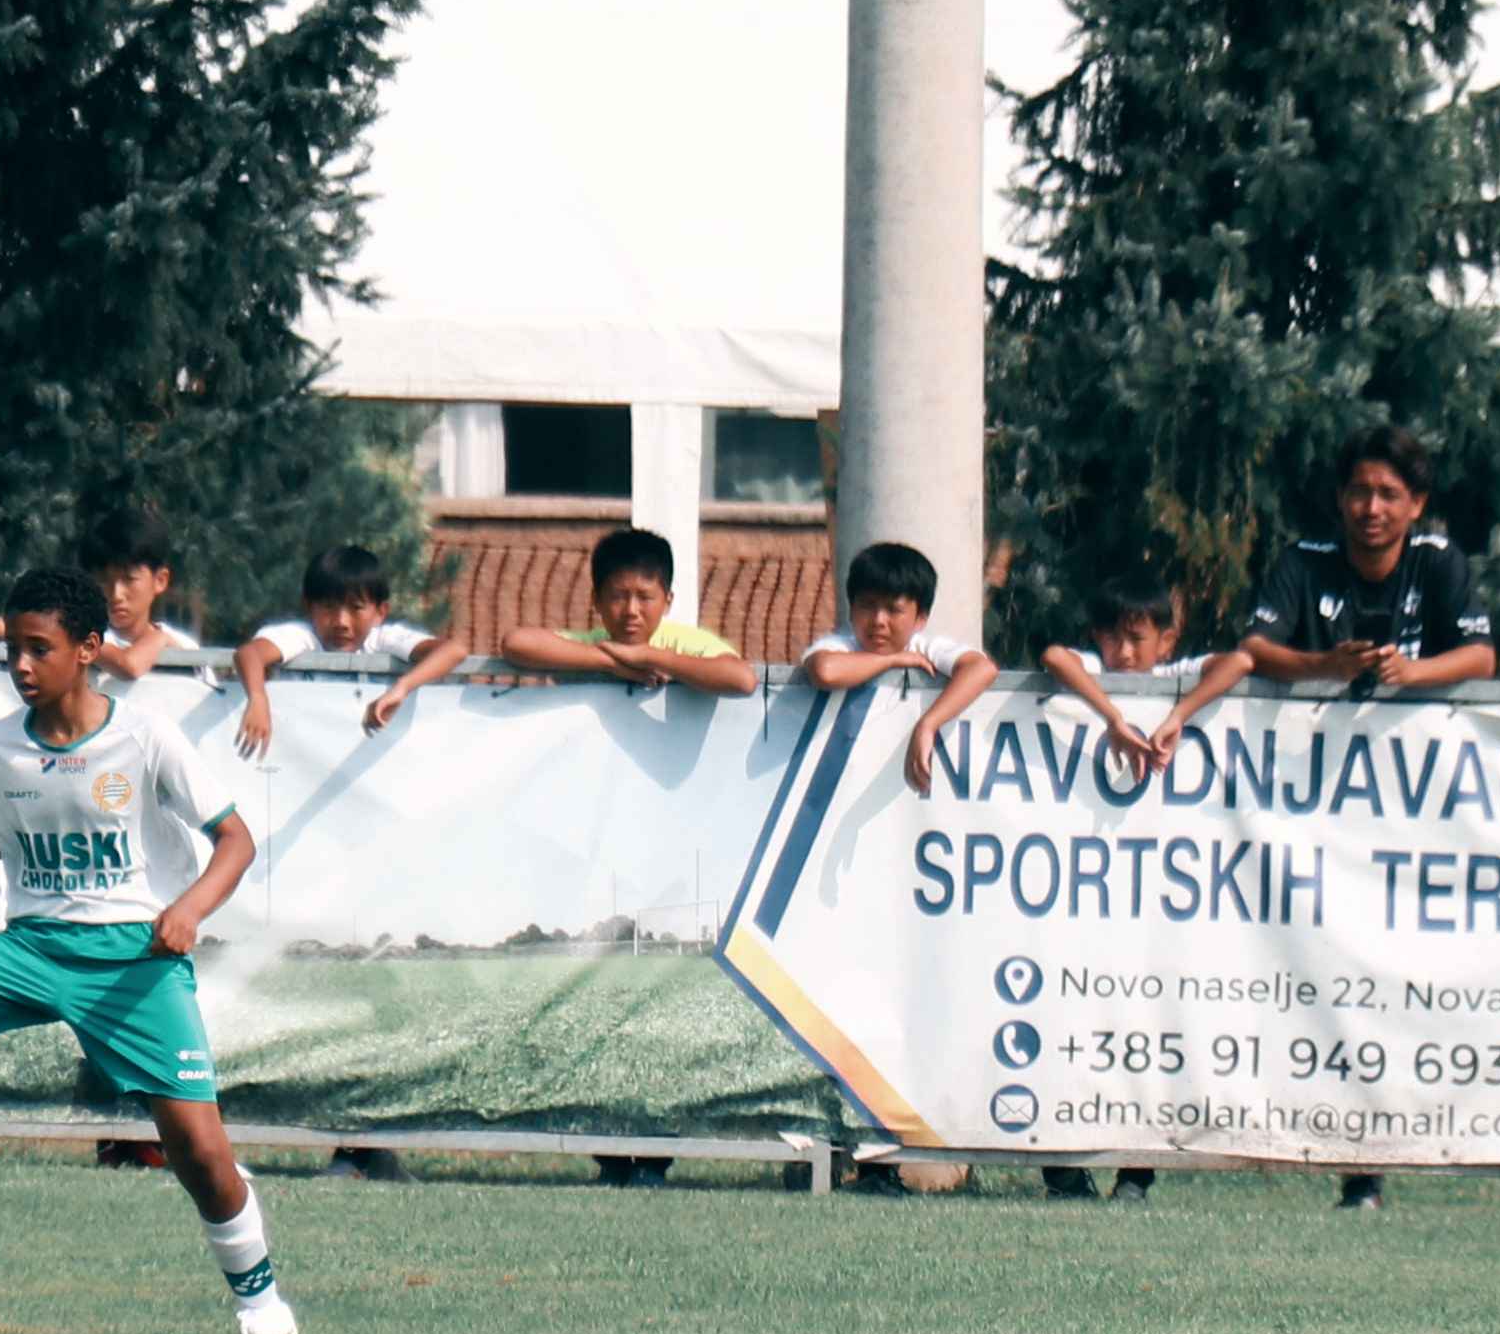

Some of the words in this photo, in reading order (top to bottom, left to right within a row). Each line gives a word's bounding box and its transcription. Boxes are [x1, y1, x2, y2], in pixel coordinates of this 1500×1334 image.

[21, 870, 133, 893] CHOCOLATE
[914, 830, 1324, 928] SPORTSKIH
[1060, 967, 1163, 999] Novo
[1178, 971, 1318, 1013] naselje
[1331, 977, 1388, 1013] 22,
[1058, 1030, 1186, 1075] +385
[1210, 1034, 1261, 1079] 91
[1288, 1038, 1387, 1084] 949
